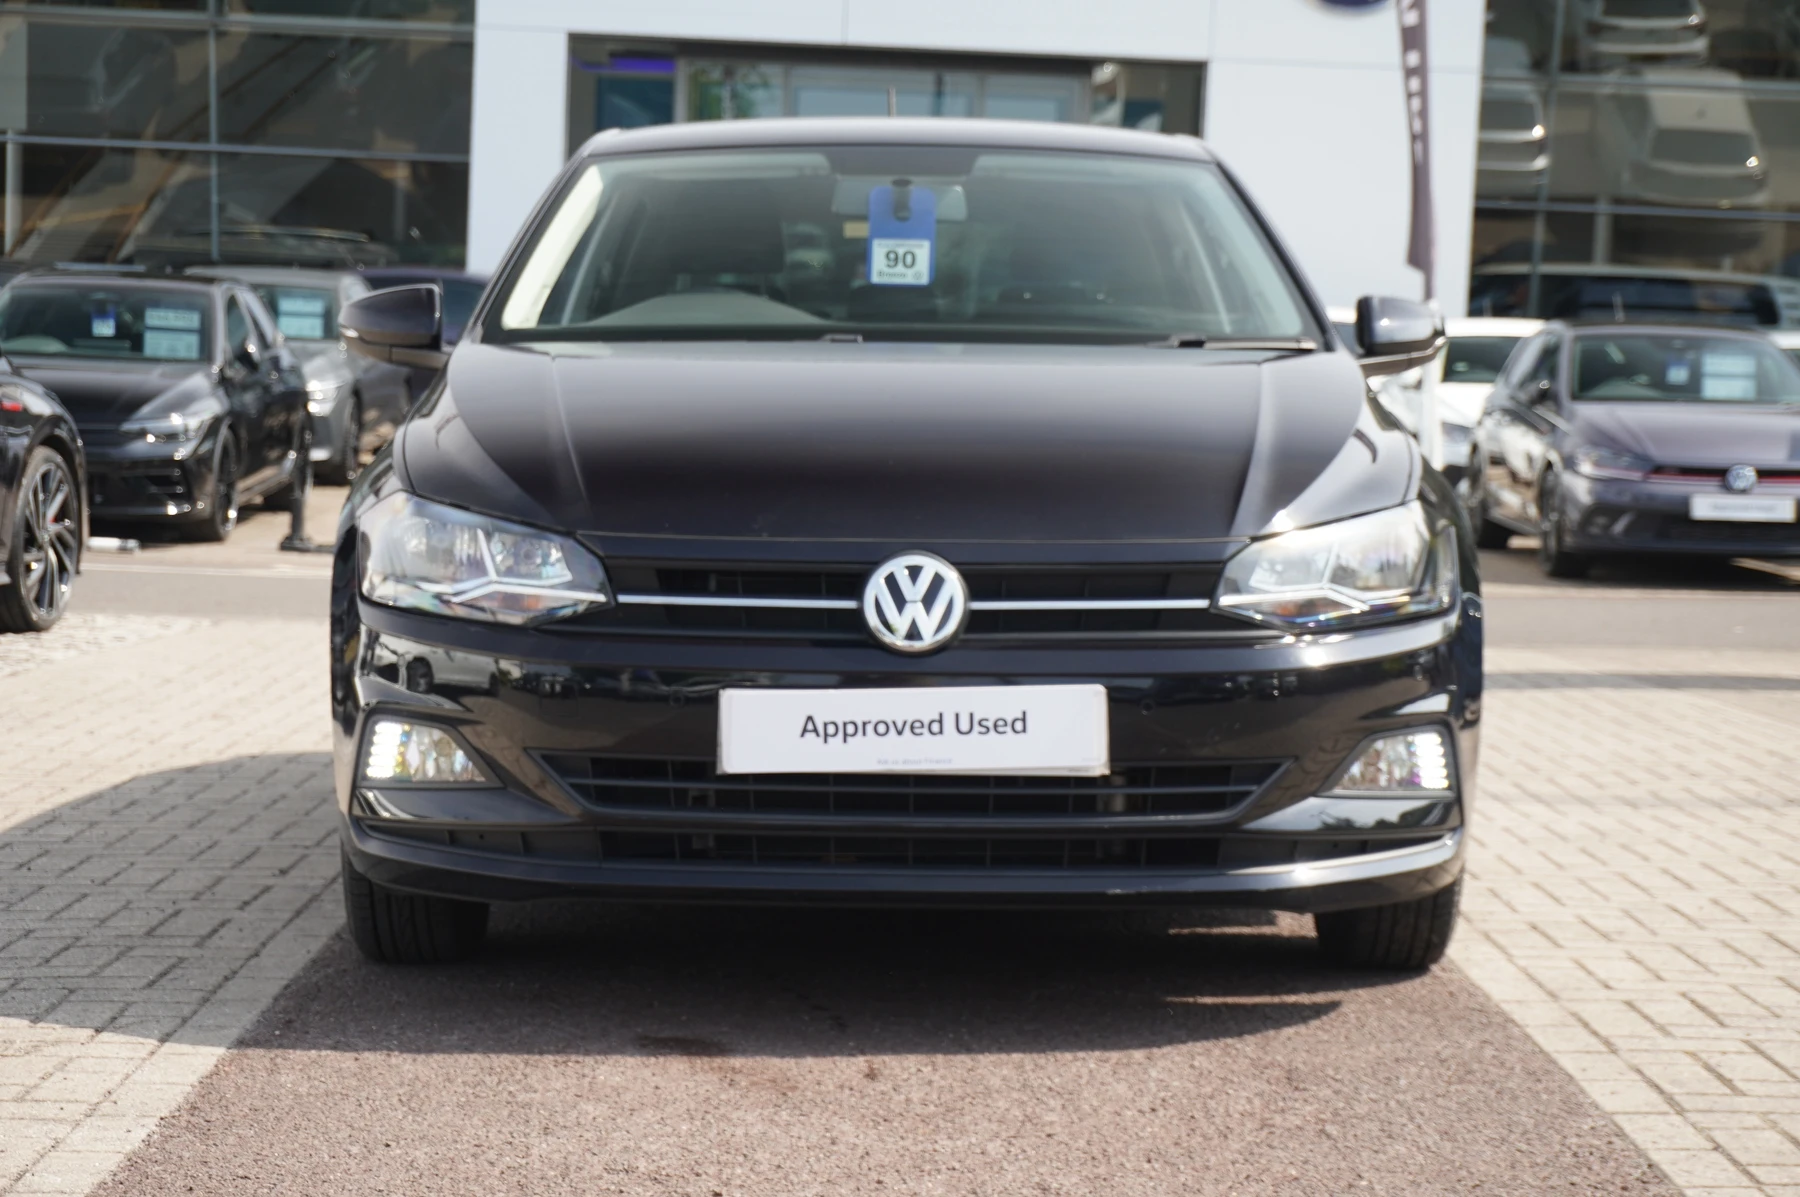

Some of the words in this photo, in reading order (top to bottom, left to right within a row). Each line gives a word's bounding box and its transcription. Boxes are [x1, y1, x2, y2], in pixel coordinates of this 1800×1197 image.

[886, 250, 916, 269] 90
[800, 712, 943, 744] Approved
[954, 710, 1028, 736] Used
